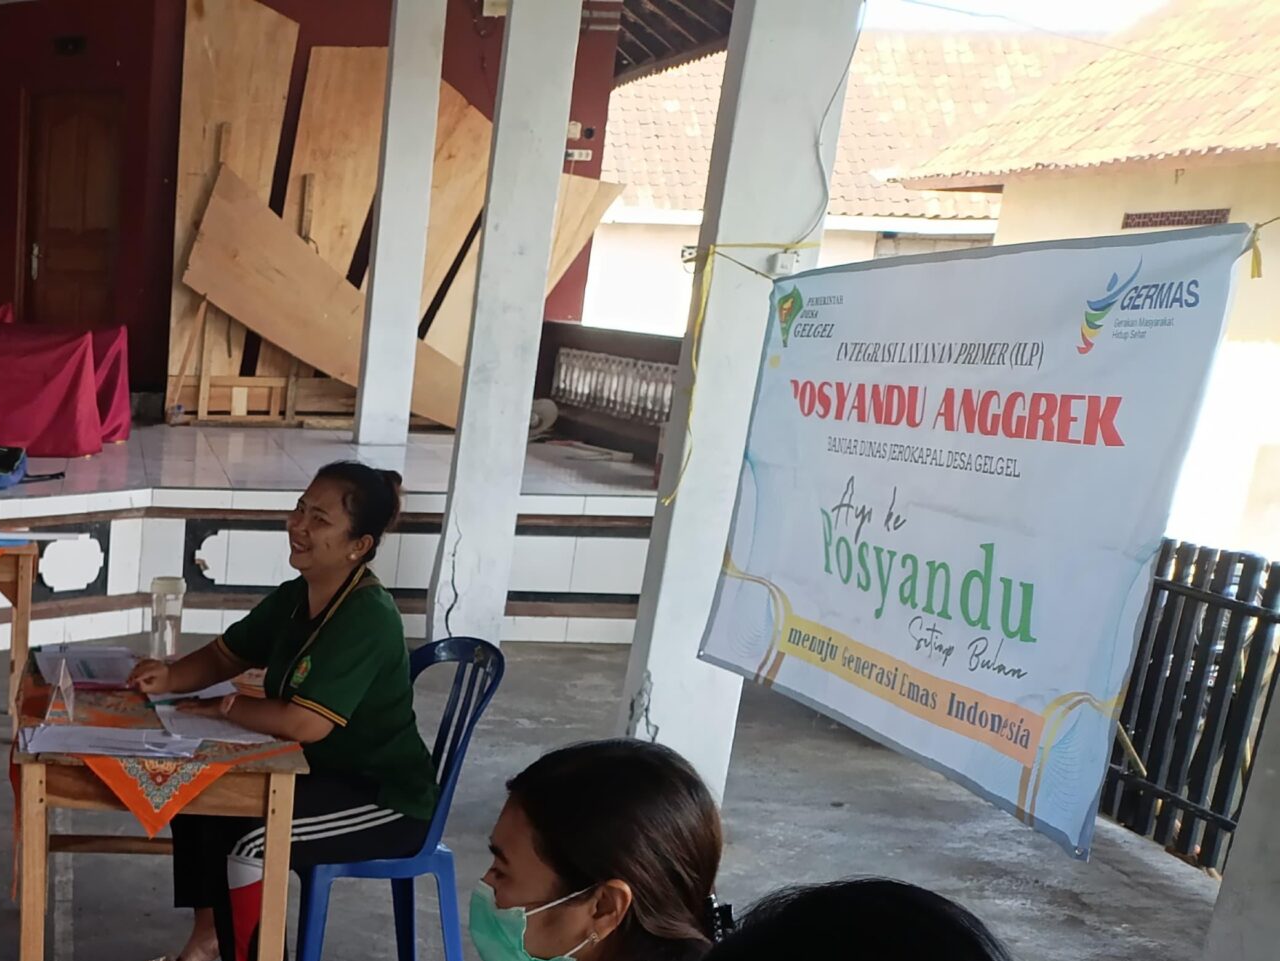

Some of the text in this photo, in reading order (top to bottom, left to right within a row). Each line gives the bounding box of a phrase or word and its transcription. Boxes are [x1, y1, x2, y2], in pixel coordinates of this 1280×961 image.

[1120, 279, 1200, 311] GERMAS
[794, 323, 835, 338] GELGEL
[836, 342, 899, 363] INTEGRASI
[953, 343, 1010, 366] PRIMER
[1009, 340, 1045, 370] (ILP)
[932, 387, 1126, 447] ANGGREK
[859, 440, 888, 460] DINAS
[887, 443, 945, 468] JEROKAPAL
[945, 449, 973, 471] DESA
[974, 453, 1021, 478] GELGEL
[884, 486, 907, 532] ke
[820, 508, 1038, 643] Posyandu
[968, 636, 1028, 680] Bulan
[787, 626, 1031, 749] menuju Generasi Emas Indonesia
